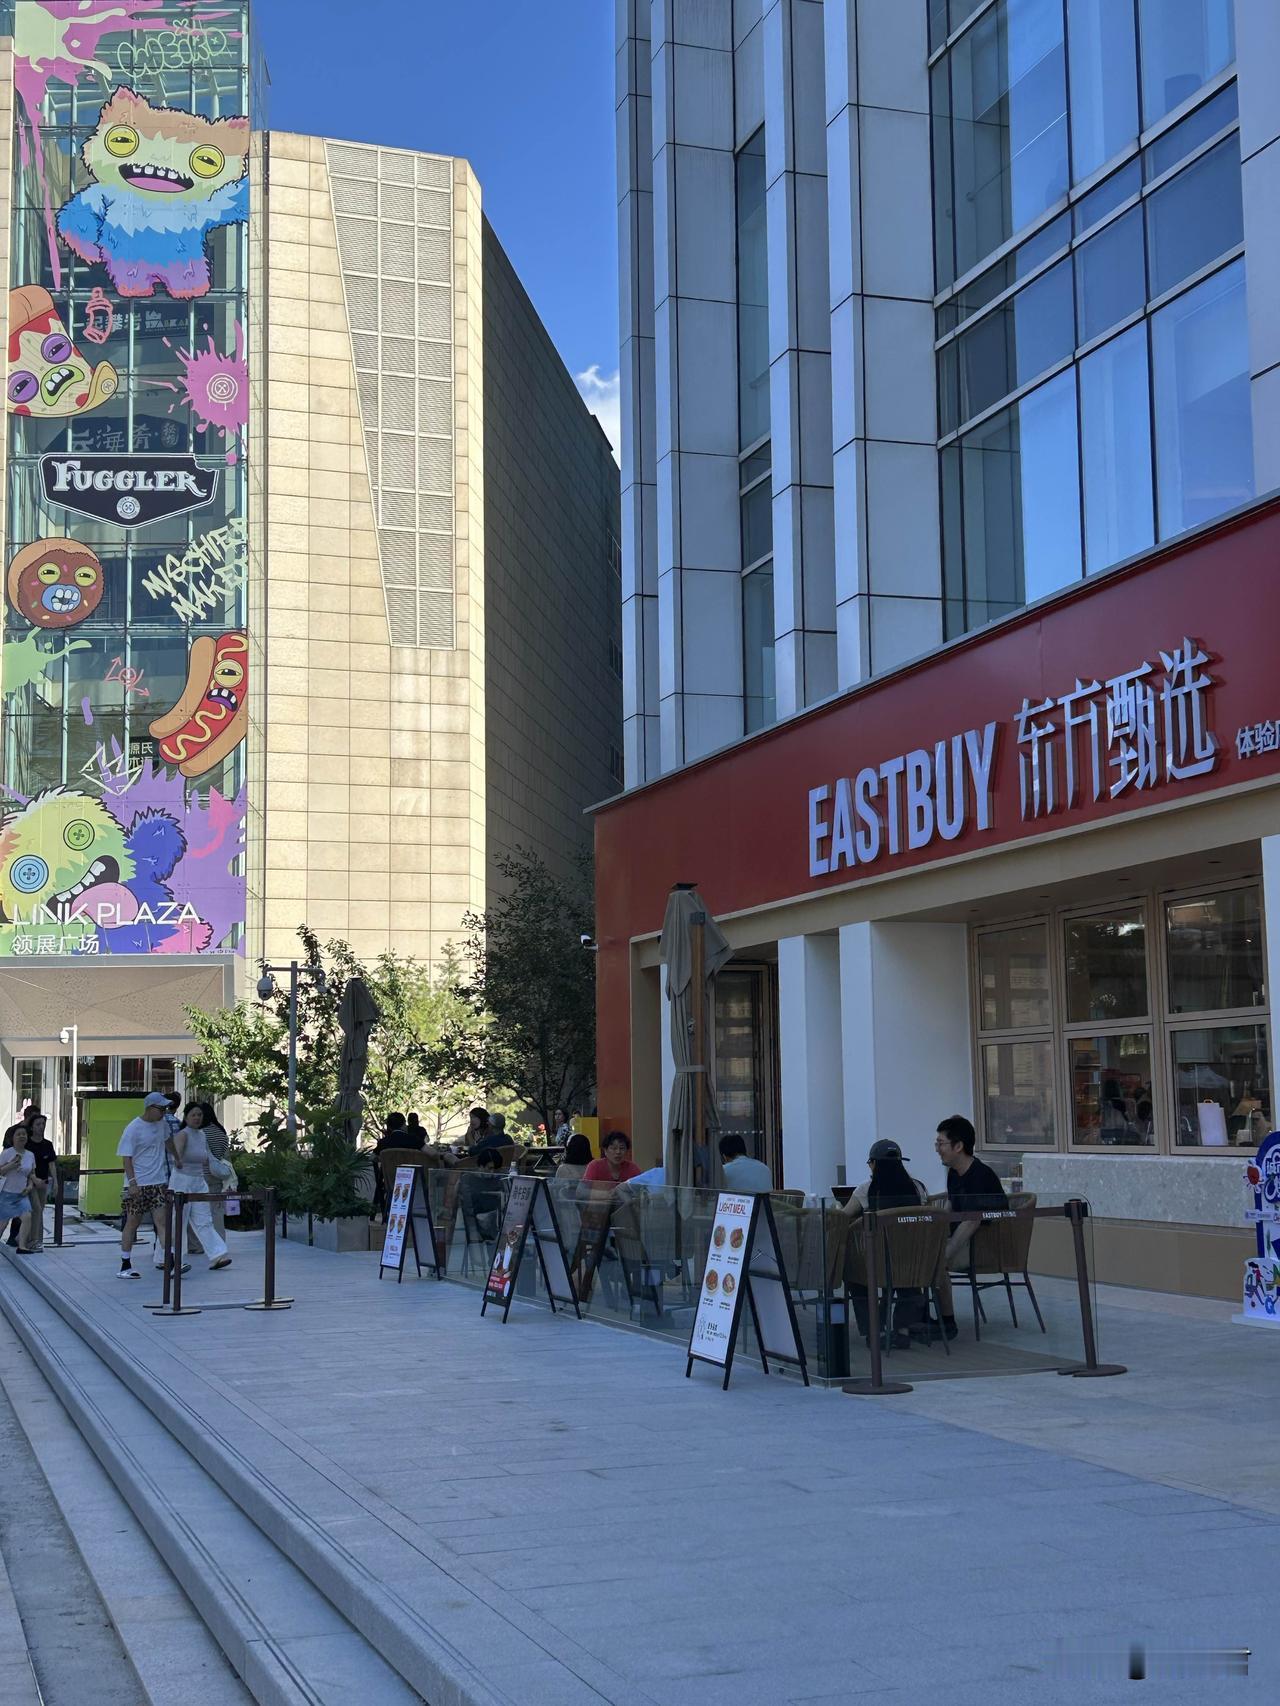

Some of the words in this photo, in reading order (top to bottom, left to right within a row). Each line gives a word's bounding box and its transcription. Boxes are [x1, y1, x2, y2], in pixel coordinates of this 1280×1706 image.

[51, 460, 207, 497] FUGGLER
[808, 721, 997, 877] EASTBUY
[1013, 636, 1216, 822] 东方甄选
[13, 903, 89, 926] LINK
[97, 902, 201, 925] PLAZA
[12, 934, 99, 955] 领展广场
